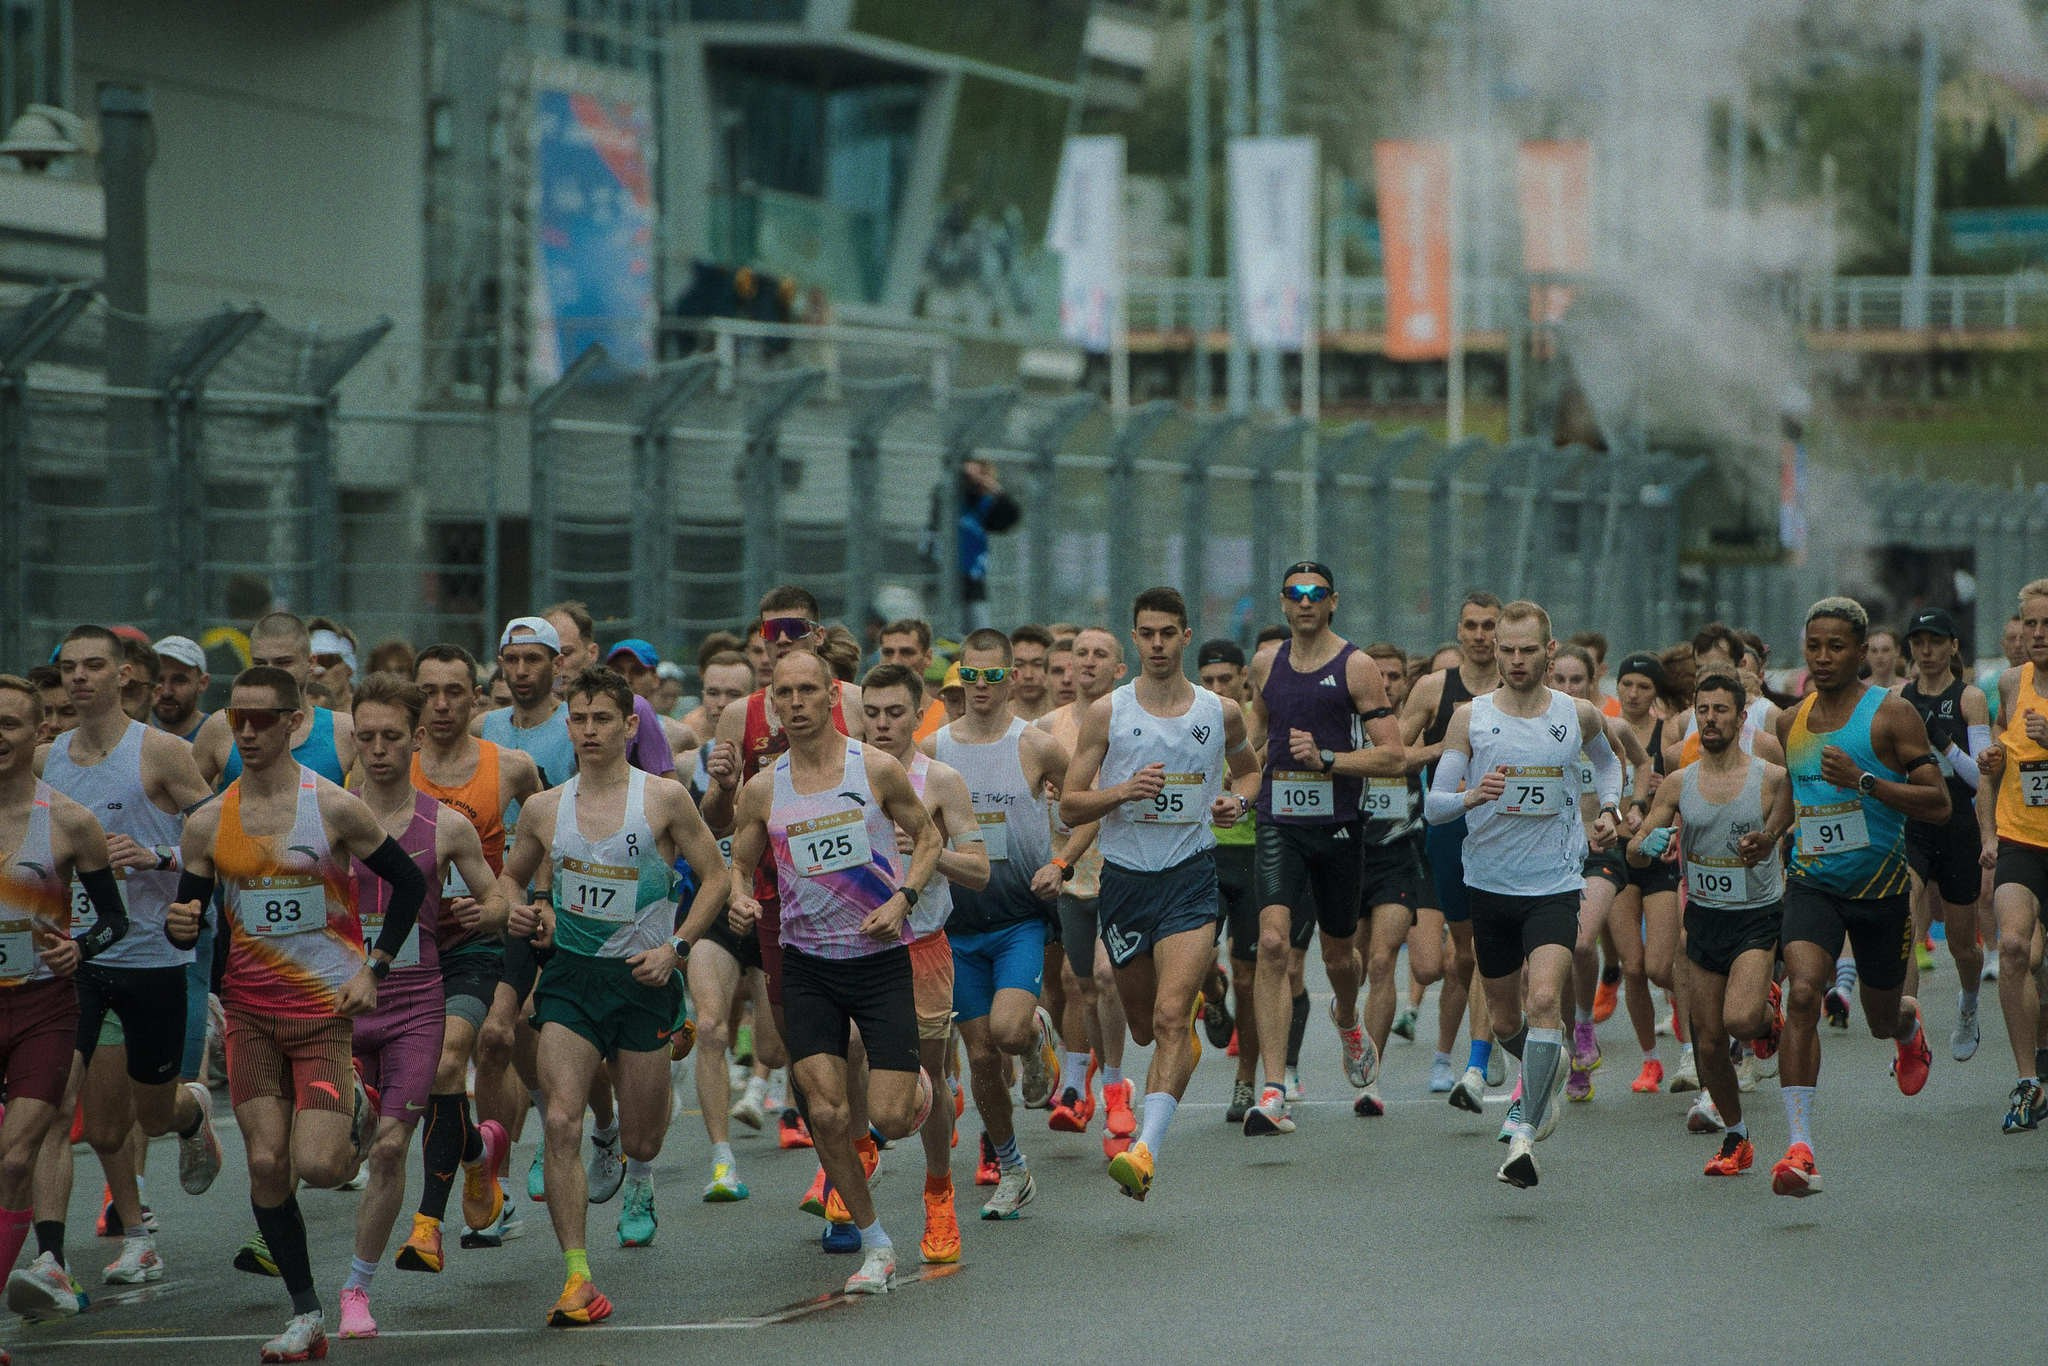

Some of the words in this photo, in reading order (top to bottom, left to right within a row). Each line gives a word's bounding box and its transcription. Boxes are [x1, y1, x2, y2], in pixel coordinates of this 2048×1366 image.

[1154, 793, 1184, 812] 95
[1284, 790, 1320, 806] 105
[1517, 786, 1545, 805] 75
[1819, 823, 1844, 844] 91
[807, 835, 853, 862] 125
[1697, 872, 1732, 893] 109
[578, 884, 616, 909] 117
[265, 899, 302, 923] 83
